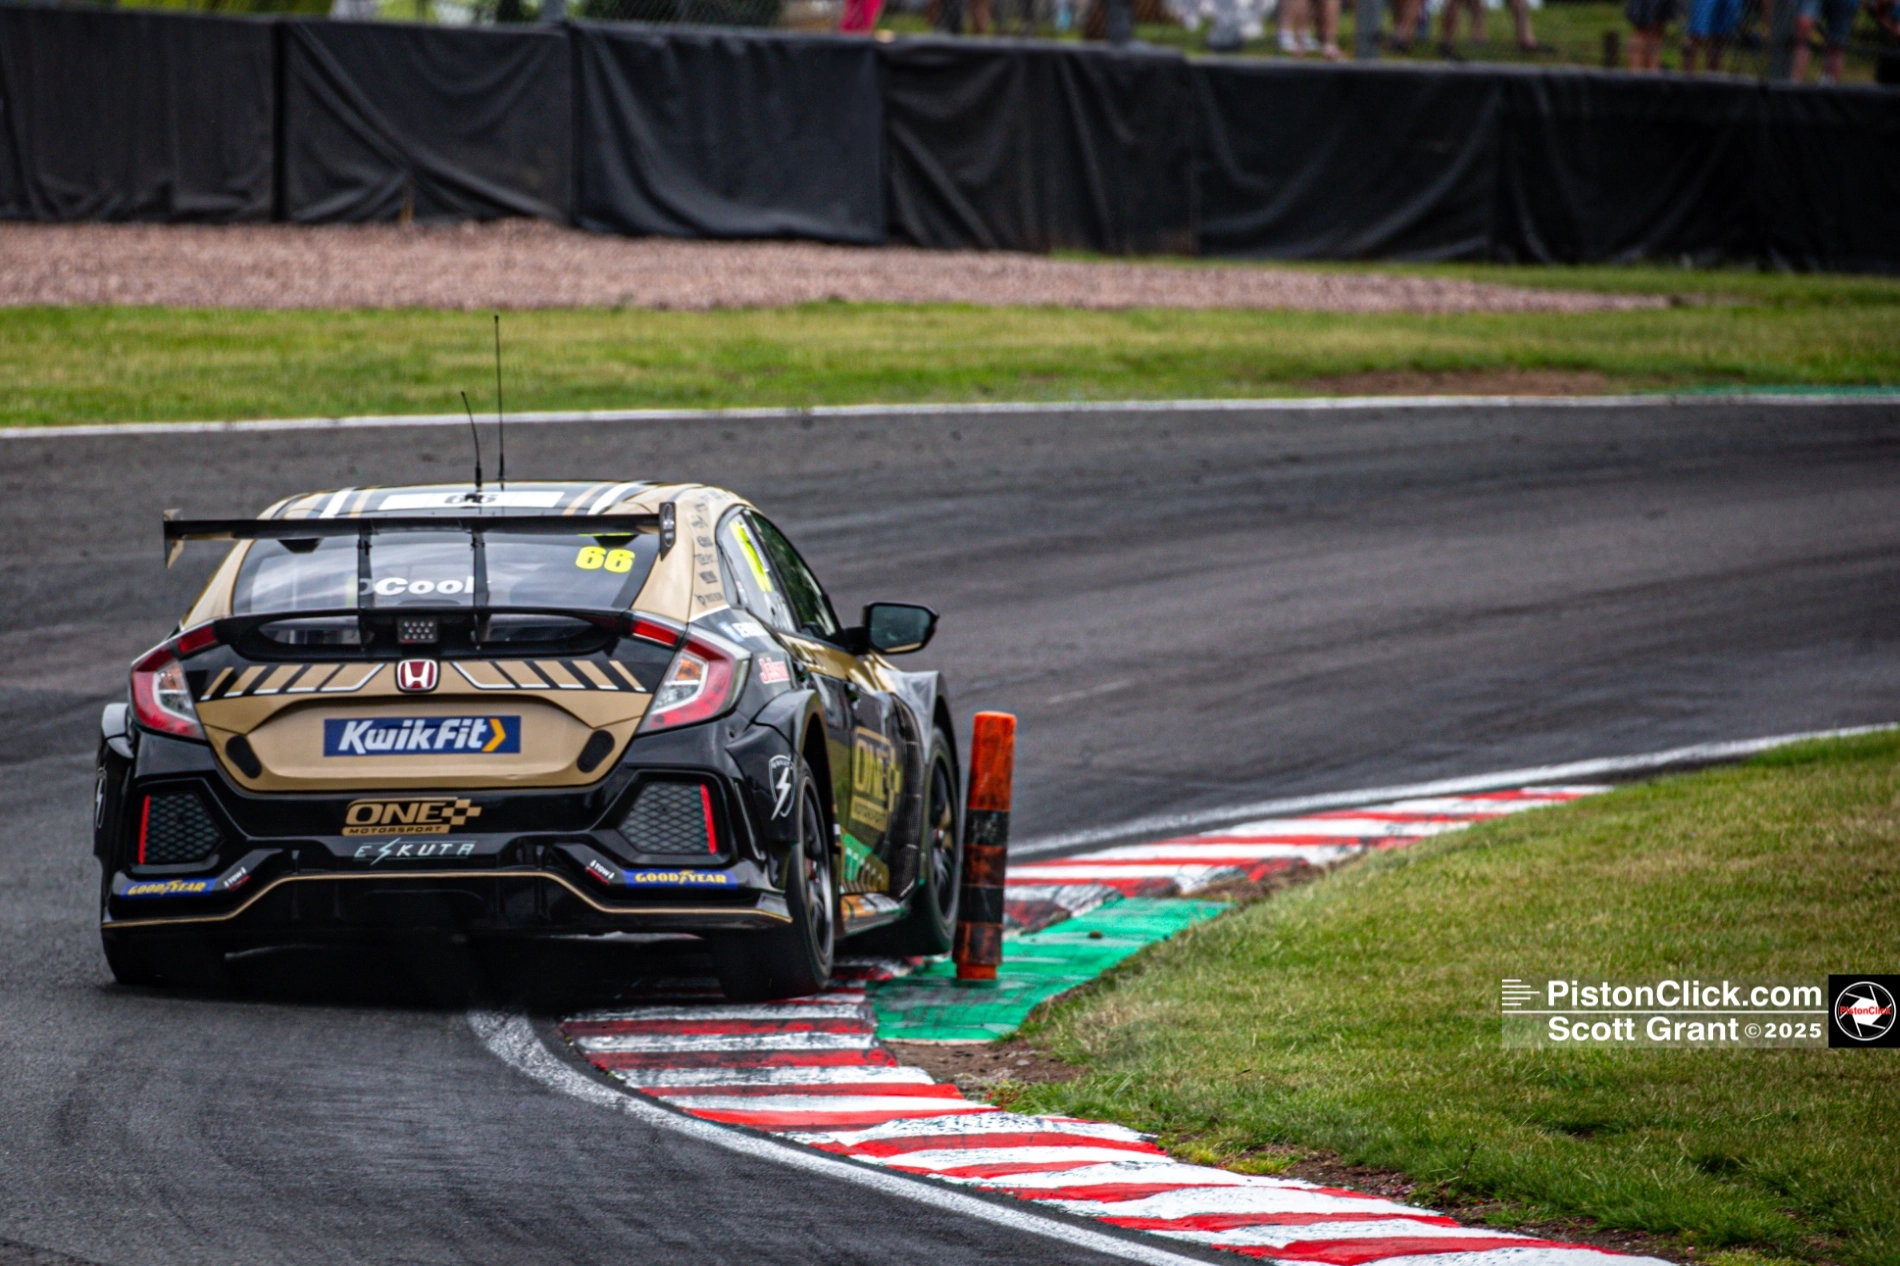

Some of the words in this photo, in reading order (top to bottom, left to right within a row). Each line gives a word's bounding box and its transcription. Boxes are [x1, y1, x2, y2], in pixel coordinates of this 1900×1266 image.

[576, 546, 635, 573] 66
[346, 802, 446, 824] ONE
[349, 826, 441, 834] MOTORSPORT
[635, 869, 726, 884] GOODYEAR
[128, 880, 207, 896] GOODYEAR
